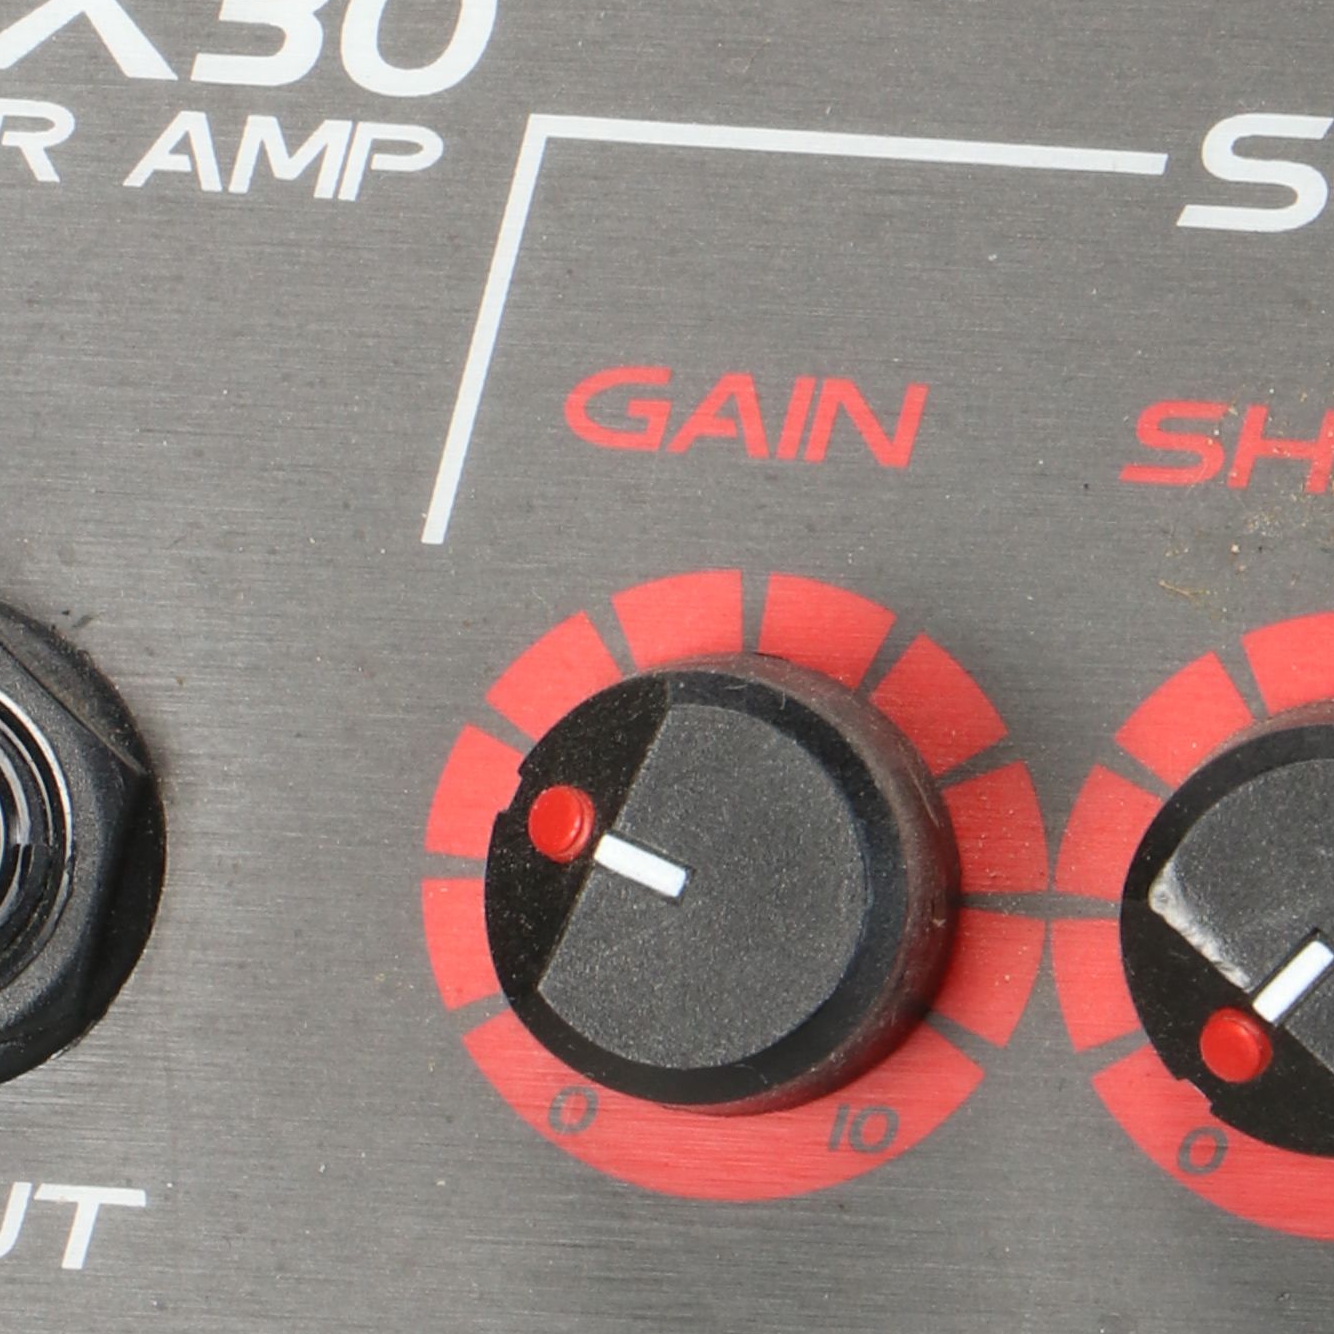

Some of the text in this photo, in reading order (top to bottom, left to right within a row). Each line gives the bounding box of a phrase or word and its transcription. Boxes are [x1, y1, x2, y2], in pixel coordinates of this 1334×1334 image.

[122, 110, 444, 203] AMP
[563, 365, 929, 469] GAIN
[826, 1104, 899, 1155] 10
[1178, 1127, 1228, 1175] 0
